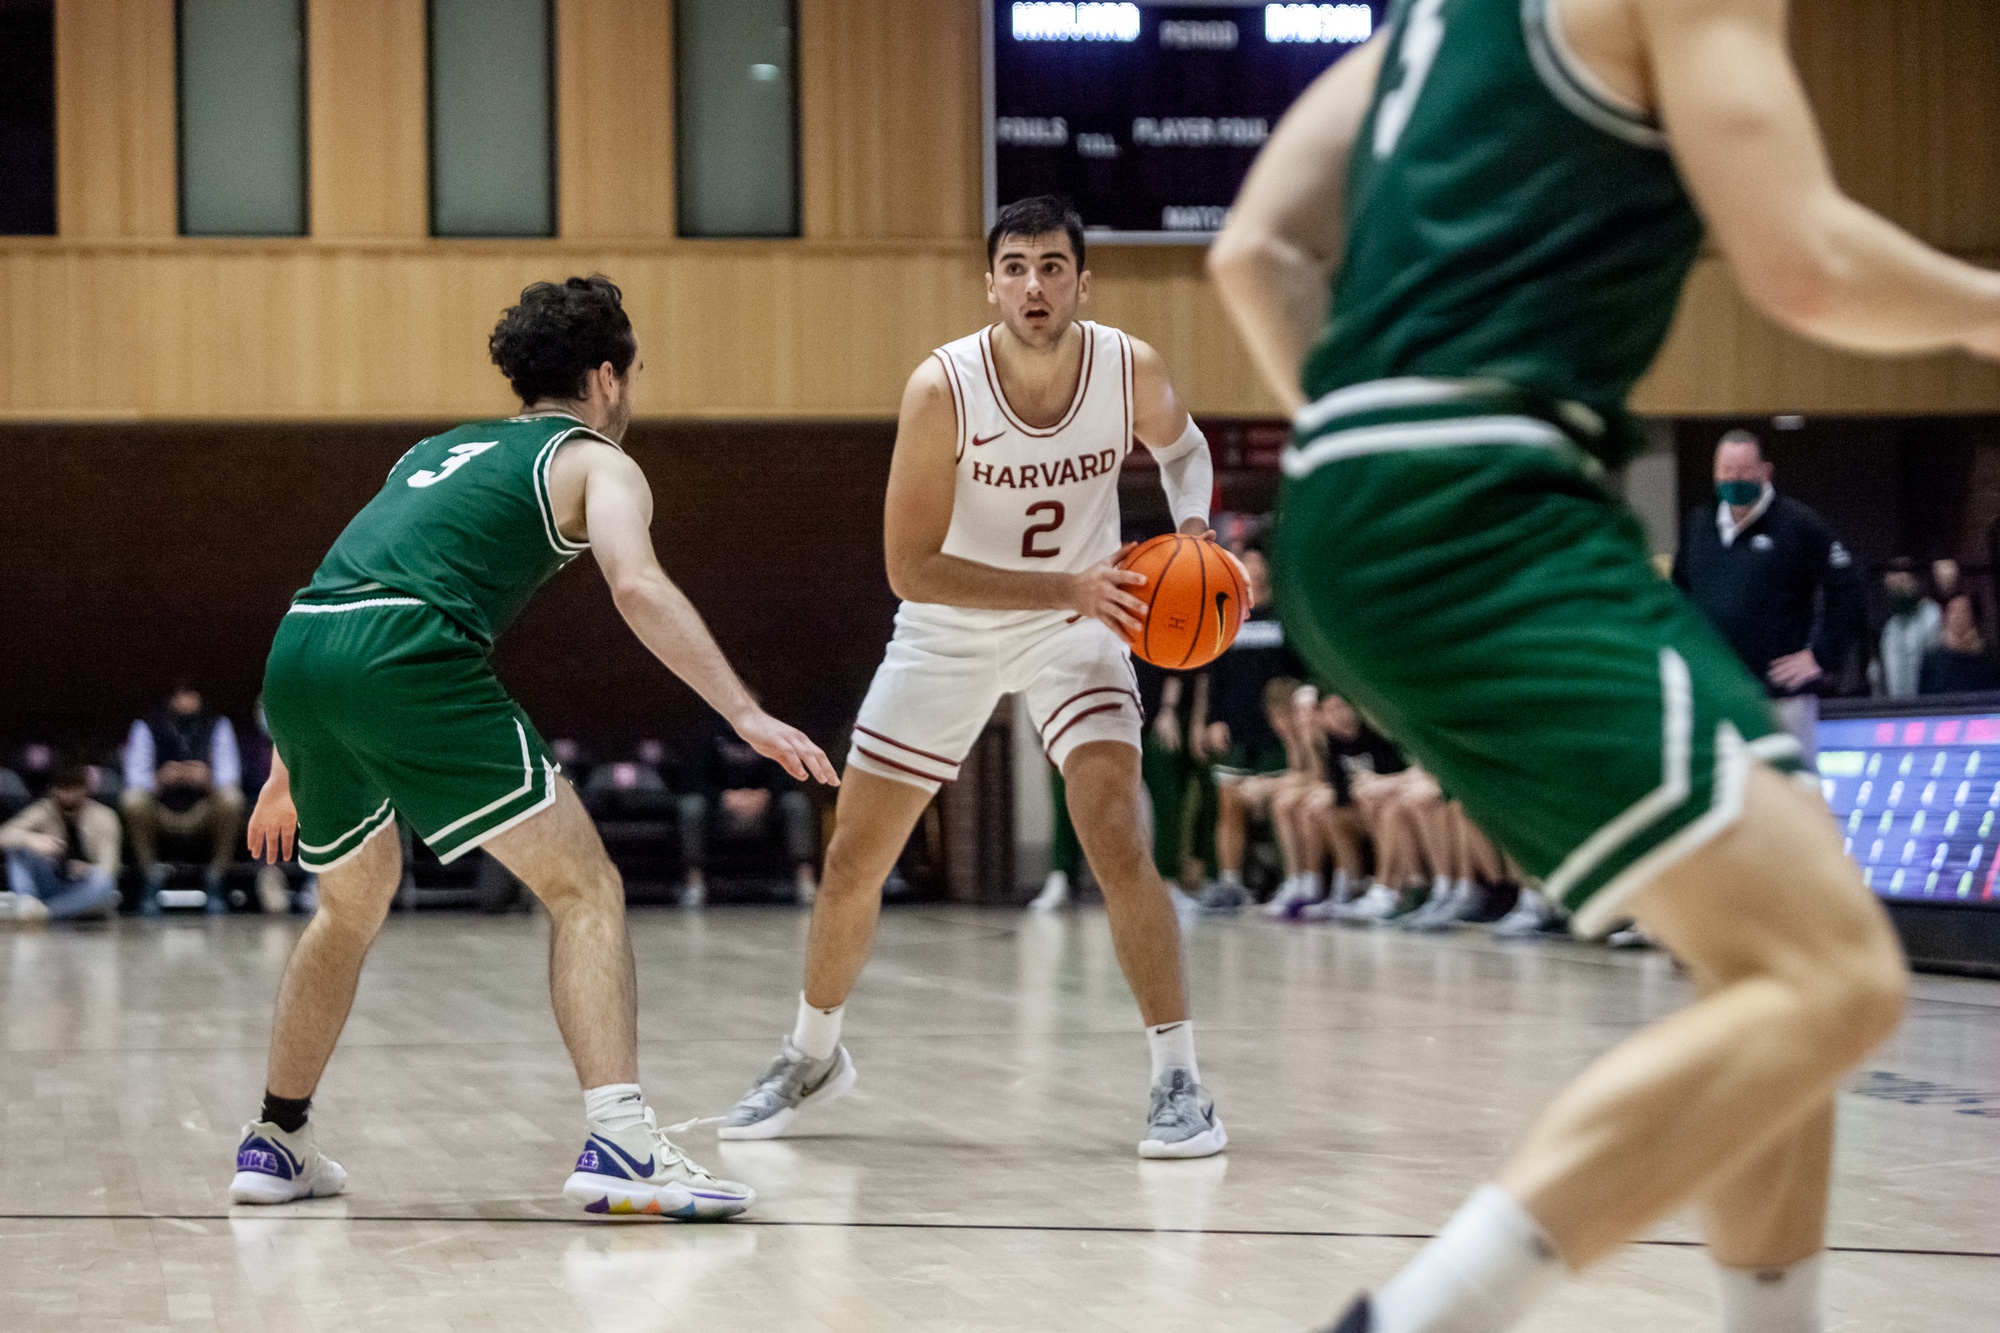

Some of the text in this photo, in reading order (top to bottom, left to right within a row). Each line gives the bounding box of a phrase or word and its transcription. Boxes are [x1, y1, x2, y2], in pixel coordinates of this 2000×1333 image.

[1132, 117, 1215, 146] PLAYER
[407, 441, 499, 488] 3
[973, 448, 1116, 489] HARVARD
[1021, 499, 1065, 559] 2
